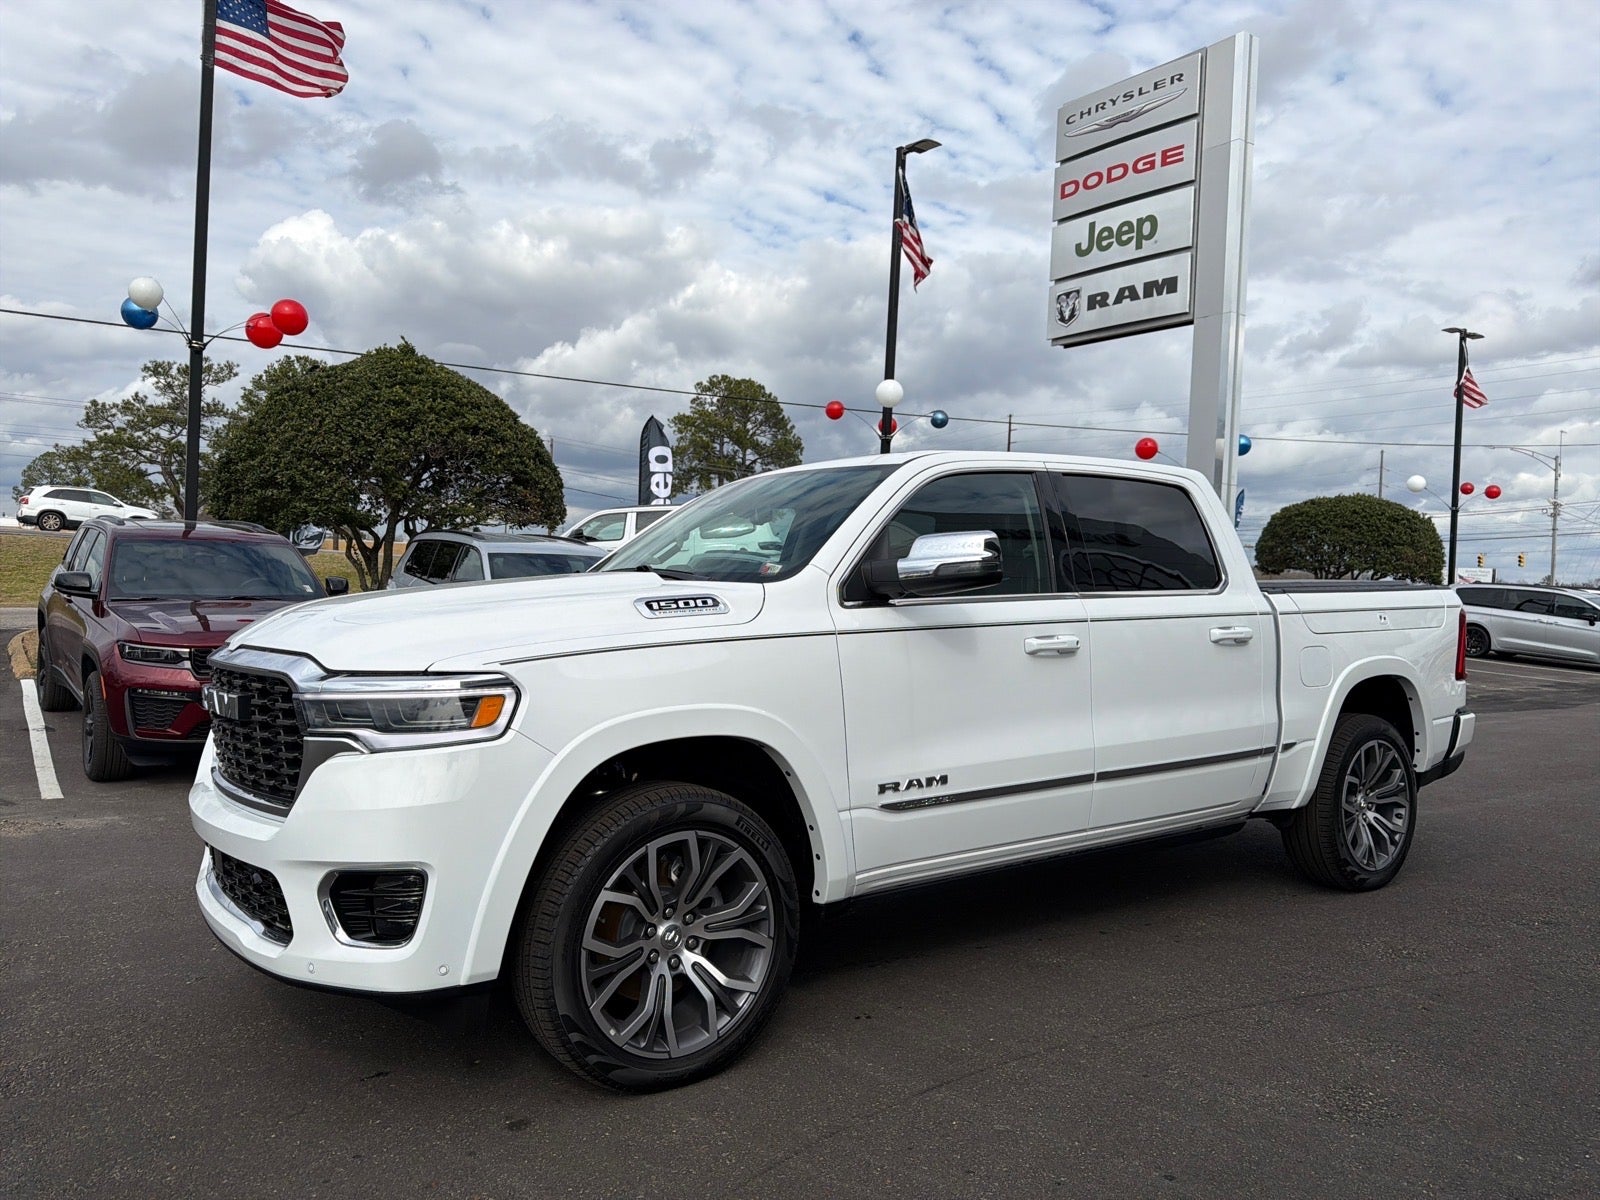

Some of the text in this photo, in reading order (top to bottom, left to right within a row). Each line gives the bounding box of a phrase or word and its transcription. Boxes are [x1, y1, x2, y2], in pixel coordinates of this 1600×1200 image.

[1065, 72, 1184, 125] CHRYSLER
[1060, 144, 1184, 200] DODGE
[1075, 214, 1158, 257] Jeep
[1087, 275, 1178, 311] RAM
[648, 446, 672, 504] ep
[649, 598, 714, 610] 1500
[878, 774, 948, 795] RAM
[735, 815, 771, 851] PIRELLI
